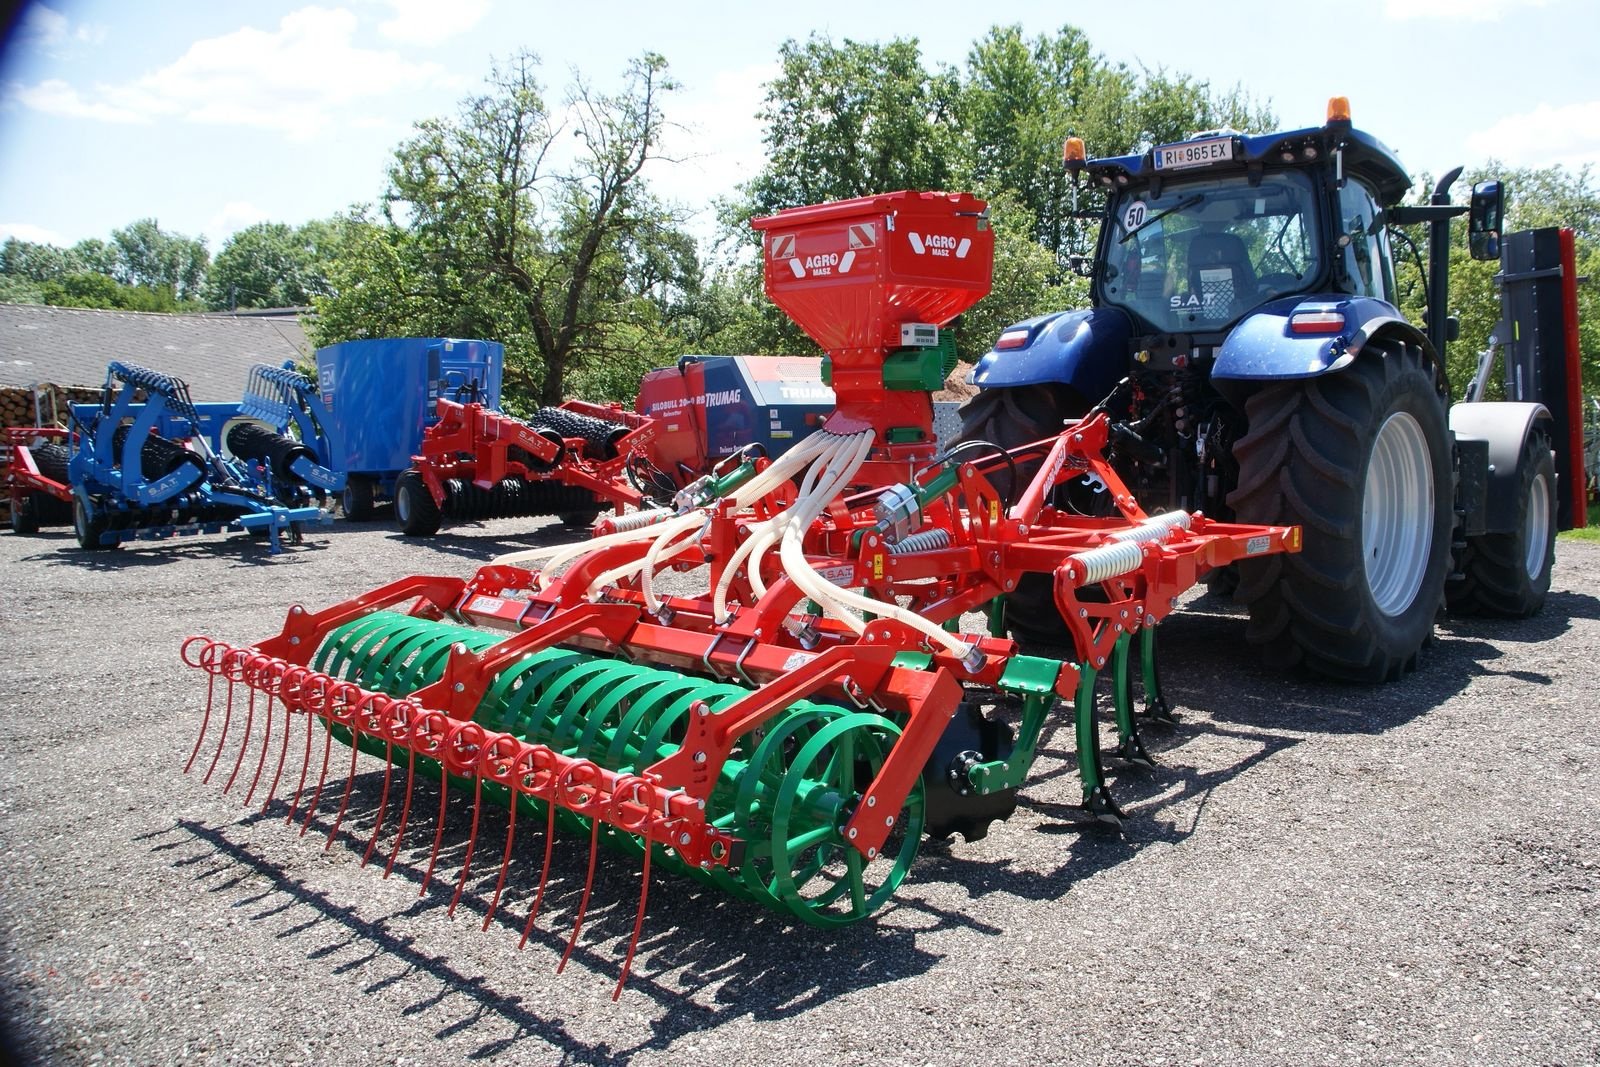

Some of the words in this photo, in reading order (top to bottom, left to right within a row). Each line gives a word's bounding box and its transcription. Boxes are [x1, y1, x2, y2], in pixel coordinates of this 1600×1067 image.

[1165, 150, 1177, 165] RI
[1186, 145, 1209, 162] 965
[1211, 142, 1226, 158] EX
[1127, 206, 1144, 227] 50
[925, 234, 957, 249] AGRO
[932, 248, 949, 257] MASZ
[805, 253, 839, 269] AGRO
[812, 267, 832, 276] MASZ
[705, 388, 741, 408] TRUMAG
[652, 400, 678, 412] SILOBULL
